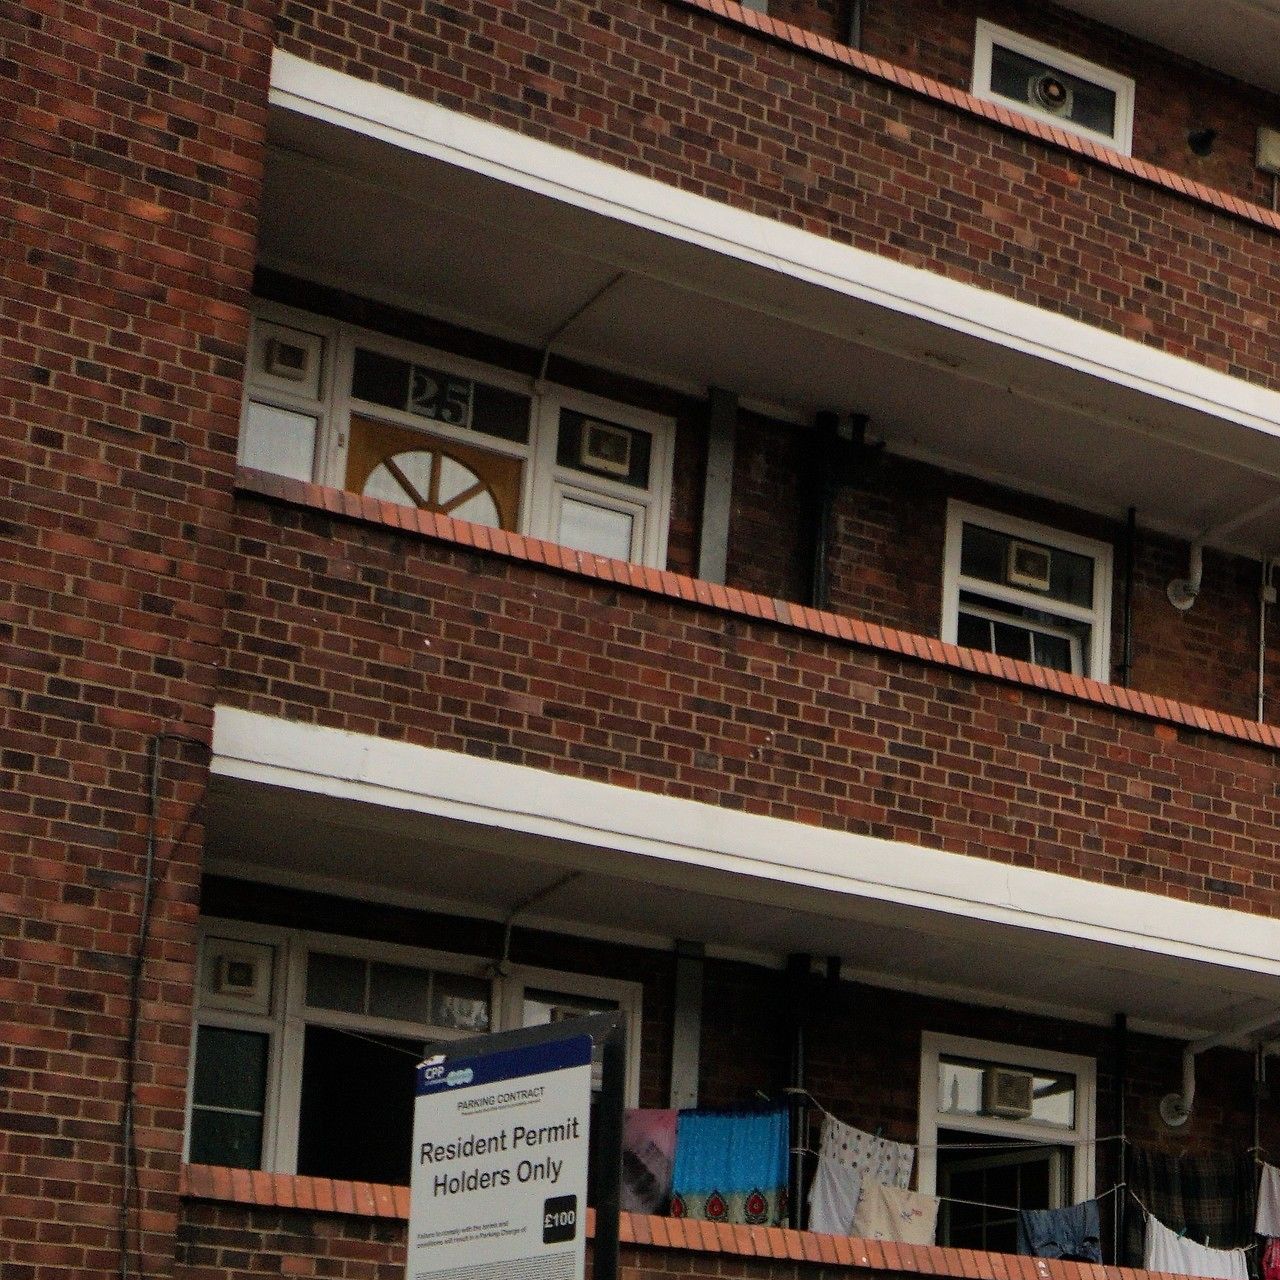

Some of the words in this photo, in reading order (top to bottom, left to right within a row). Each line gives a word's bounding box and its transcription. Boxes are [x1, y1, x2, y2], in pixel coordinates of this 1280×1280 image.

[412, 373, 468, 424] 25
[457, 1095, 496, 1111] PARKING
[497, 1086, 545, 1104] CONTRACT
[420, 1130, 508, 1165] Resident
[512, 1116, 580, 1149] Permit
[433, 1167, 511, 1197] Holders
[516, 1157, 563, 1184] Only
[544, 1210, 575, 1228] £100
